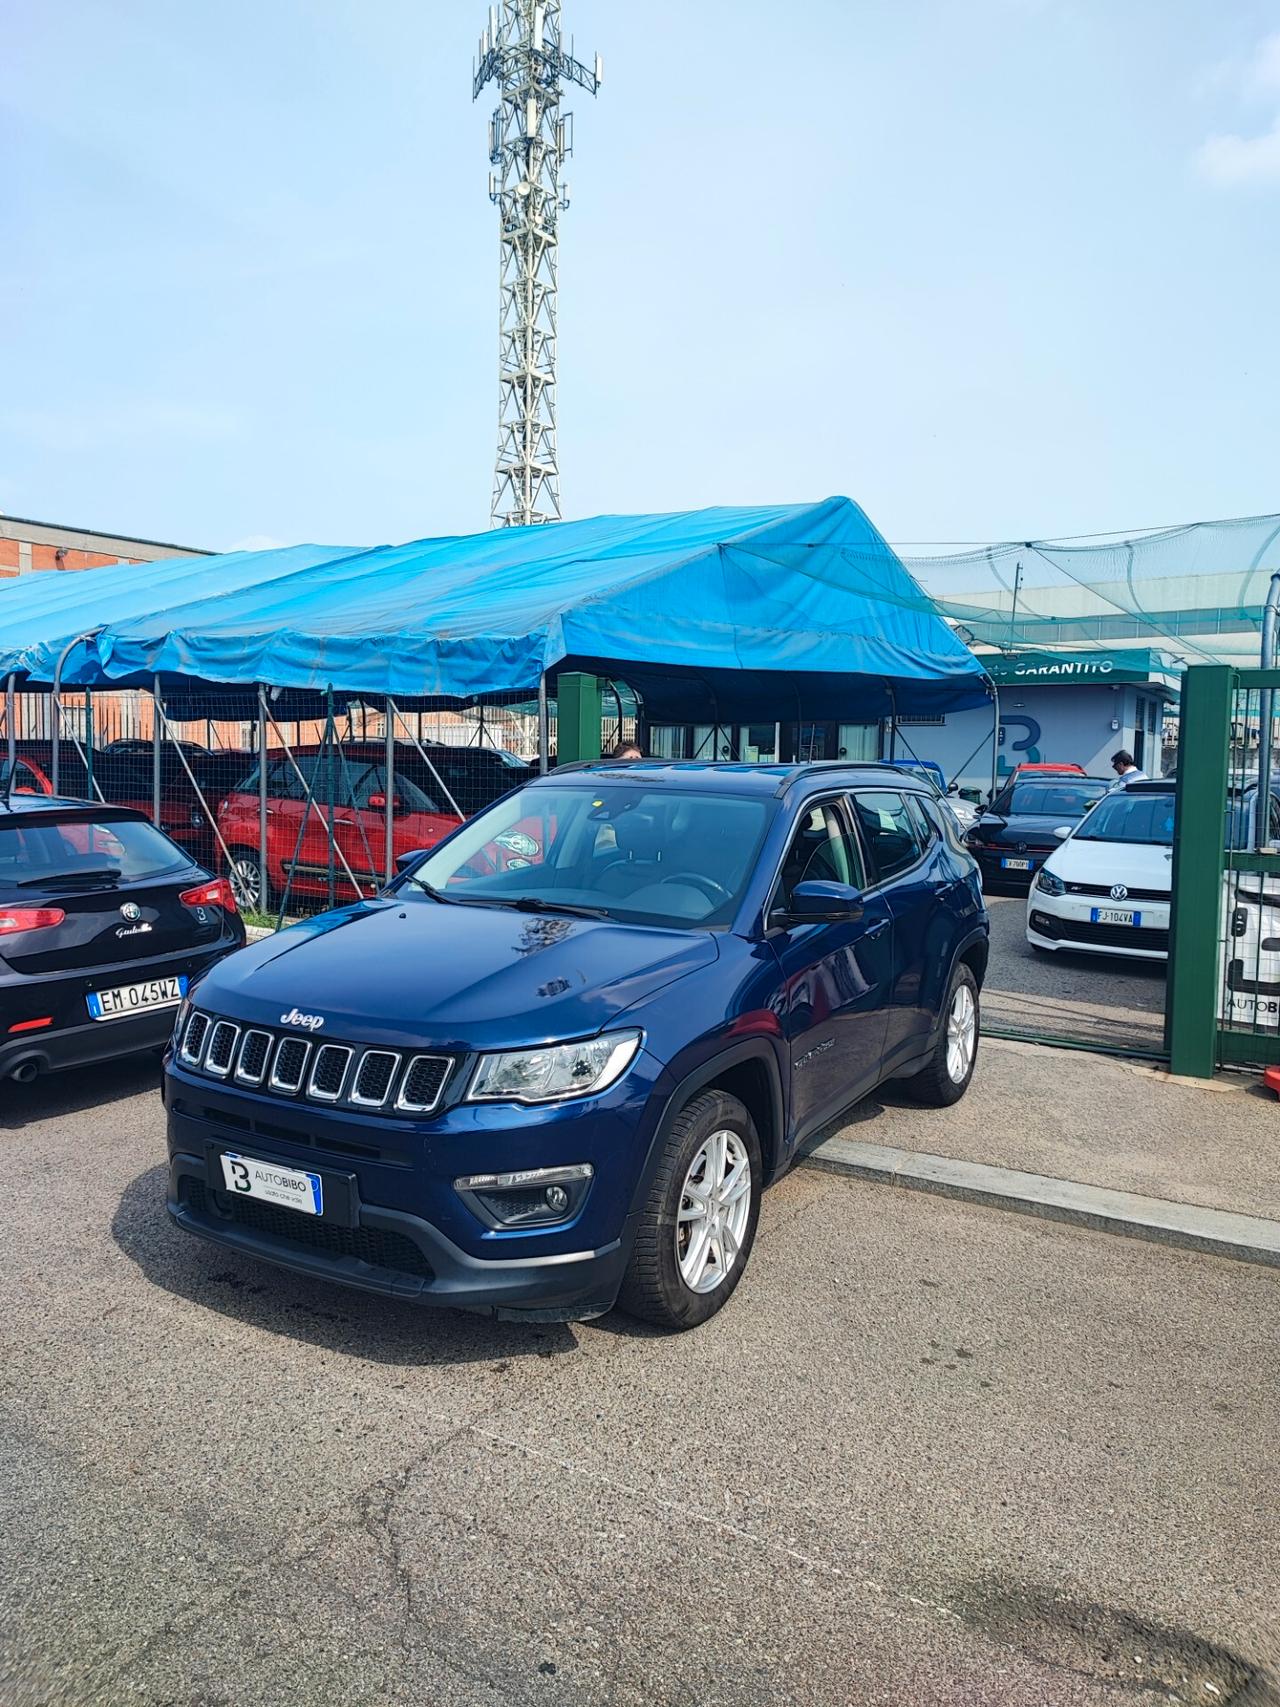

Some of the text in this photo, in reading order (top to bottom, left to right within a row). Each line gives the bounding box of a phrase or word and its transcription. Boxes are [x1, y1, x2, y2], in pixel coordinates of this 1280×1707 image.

[1014, 660, 1113, 676] GARANTITO
[1227, 997, 1280, 1014] AUTOB
[280, 1008, 325, 1031] Jeep
[255, 1170, 307, 1192] AUTOBIBO
